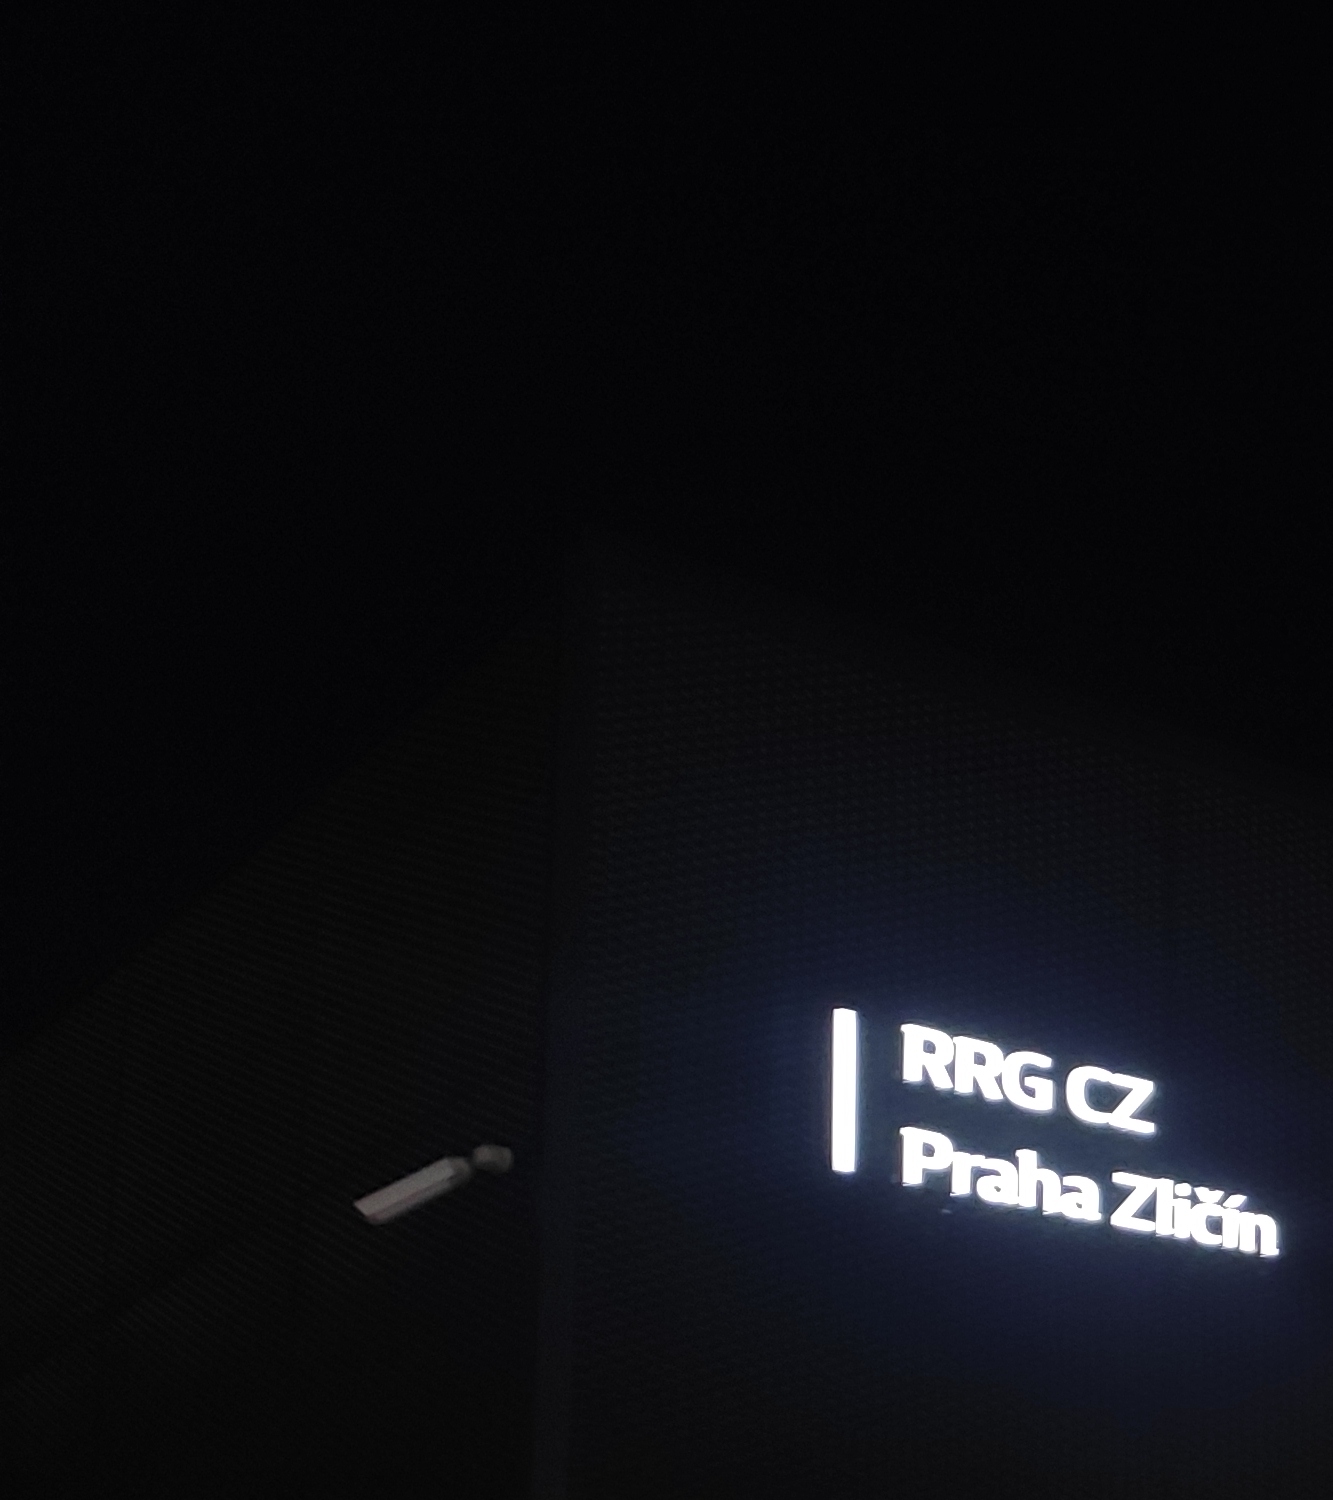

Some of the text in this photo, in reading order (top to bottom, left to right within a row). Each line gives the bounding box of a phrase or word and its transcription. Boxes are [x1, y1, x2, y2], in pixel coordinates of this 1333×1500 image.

[900, 1023, 1157, 1136] RRG CZ
[899, 1126, 1280, 1258] Praha Zličín
